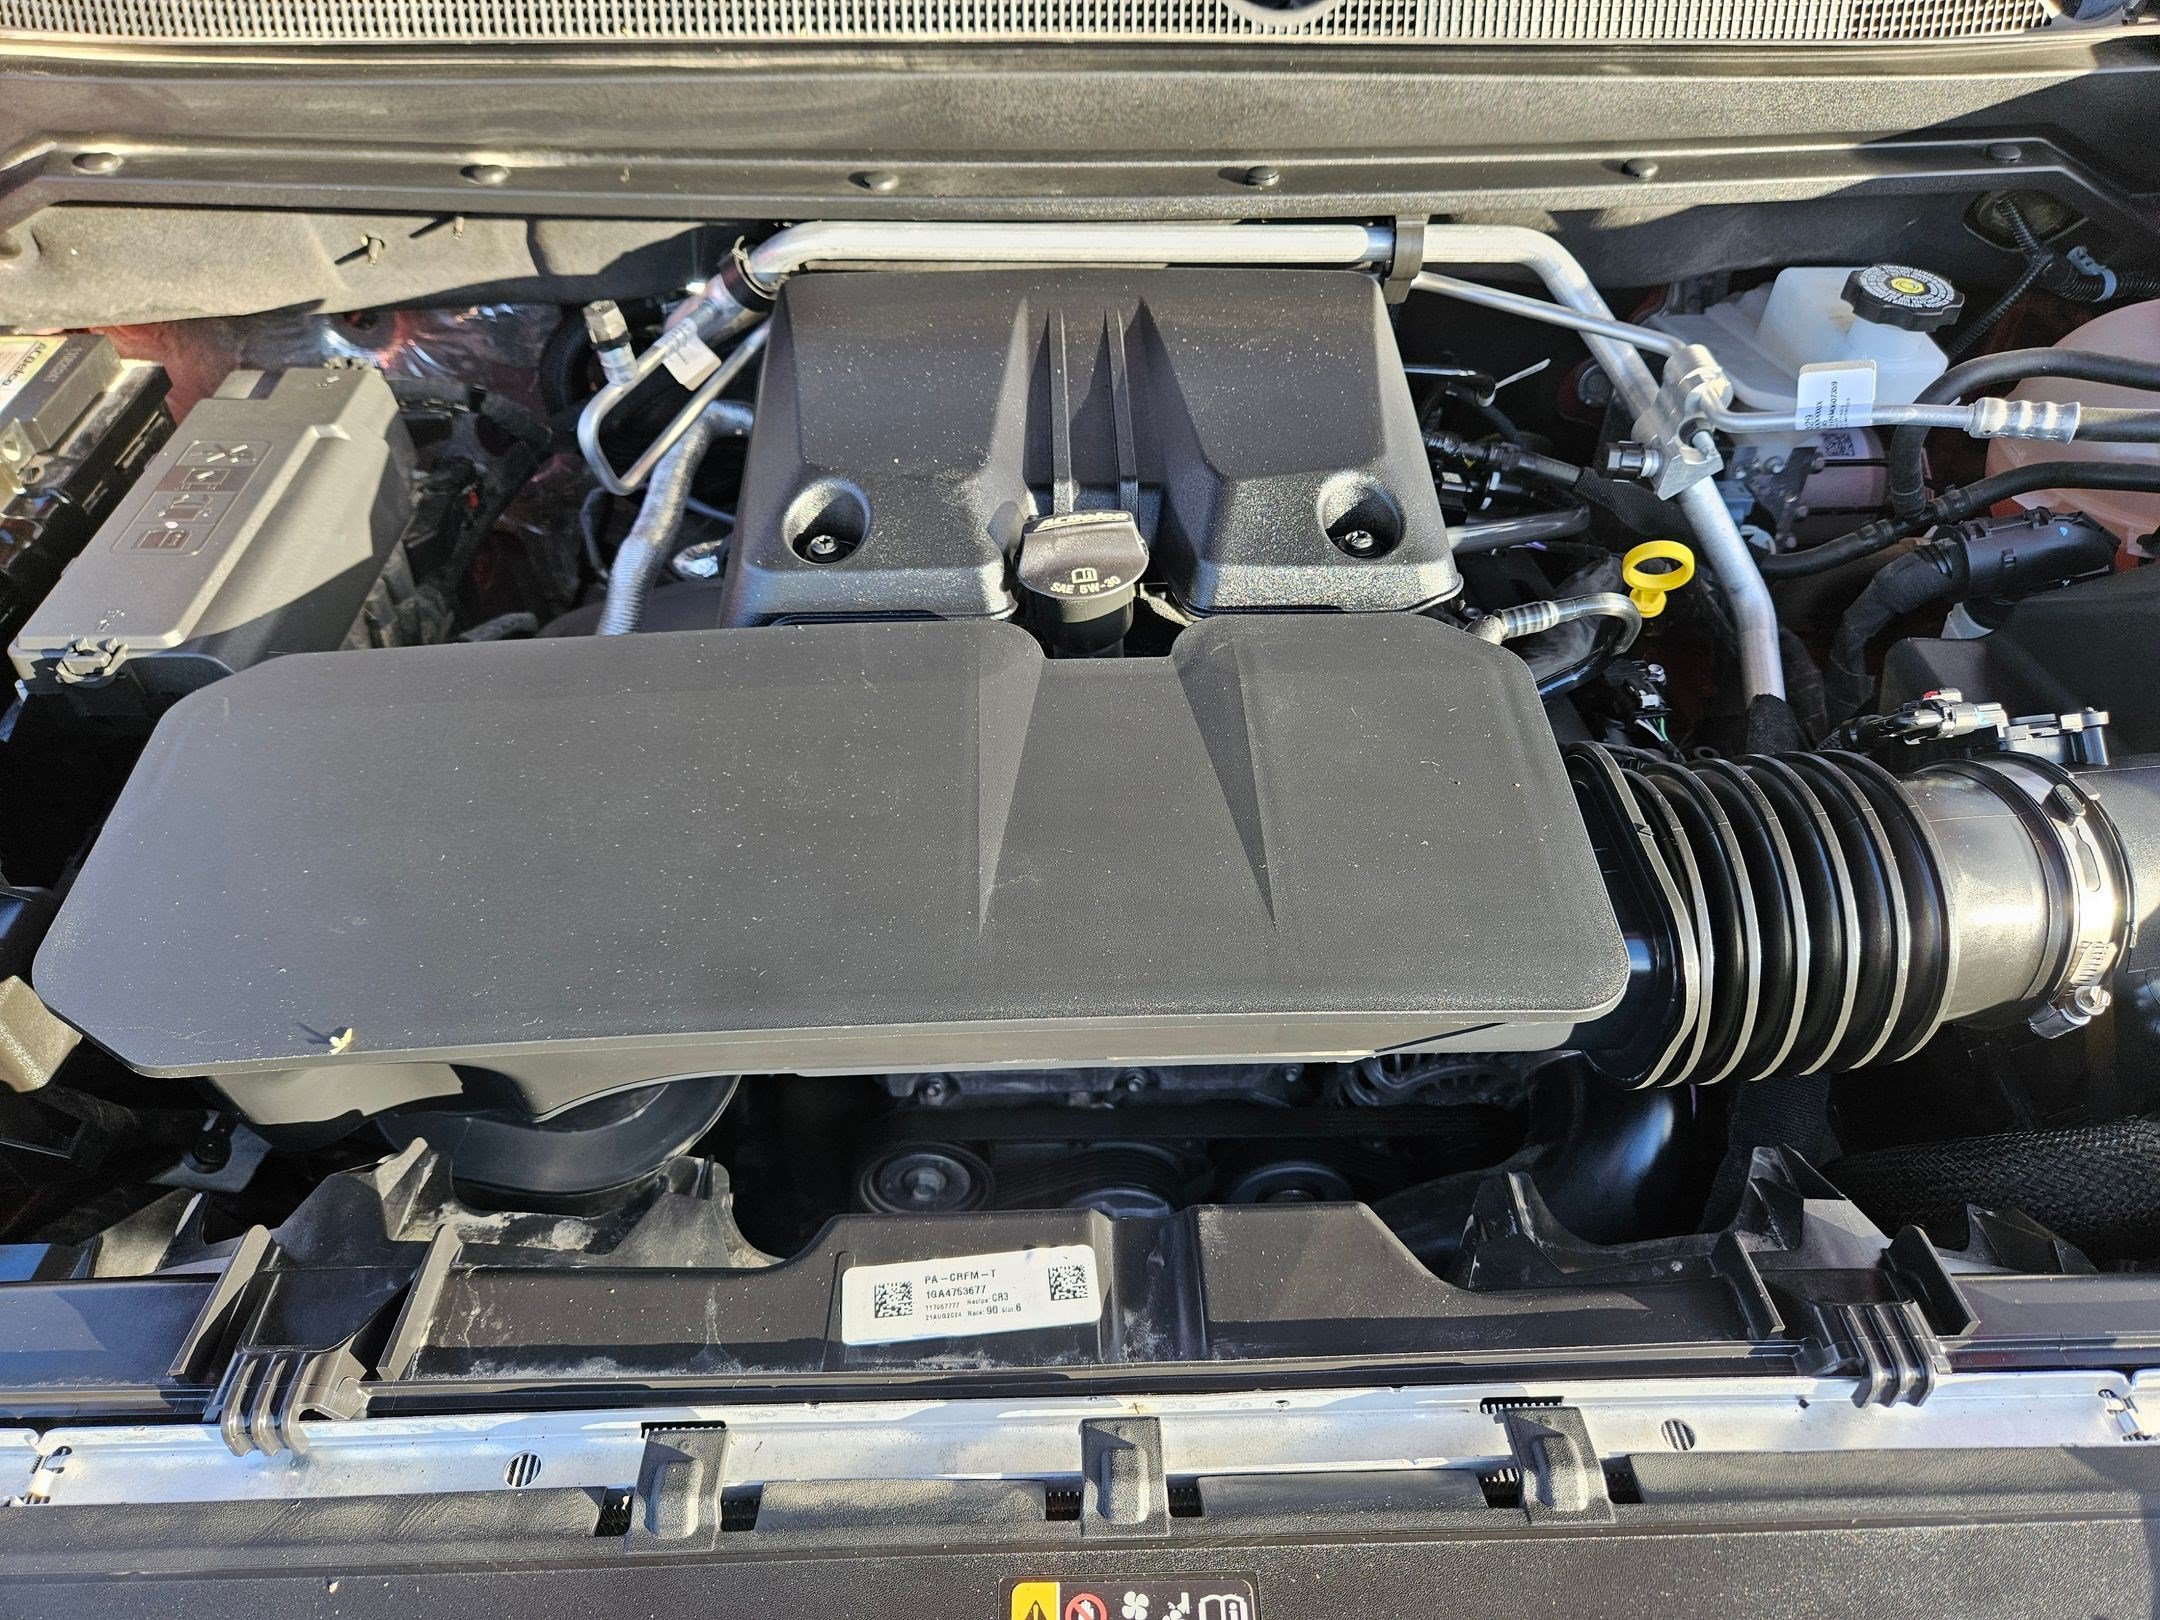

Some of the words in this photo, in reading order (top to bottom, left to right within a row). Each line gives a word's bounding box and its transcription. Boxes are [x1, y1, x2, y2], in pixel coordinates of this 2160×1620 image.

[1050, 582, 1075, 595] SAE
[1079, 575, 1121, 594] 5W-30
[991, 1292, 1009, 1302] CR3
[986, 1305, 998, 1315] 90
[1015, 1303, 1022, 1312] 6
